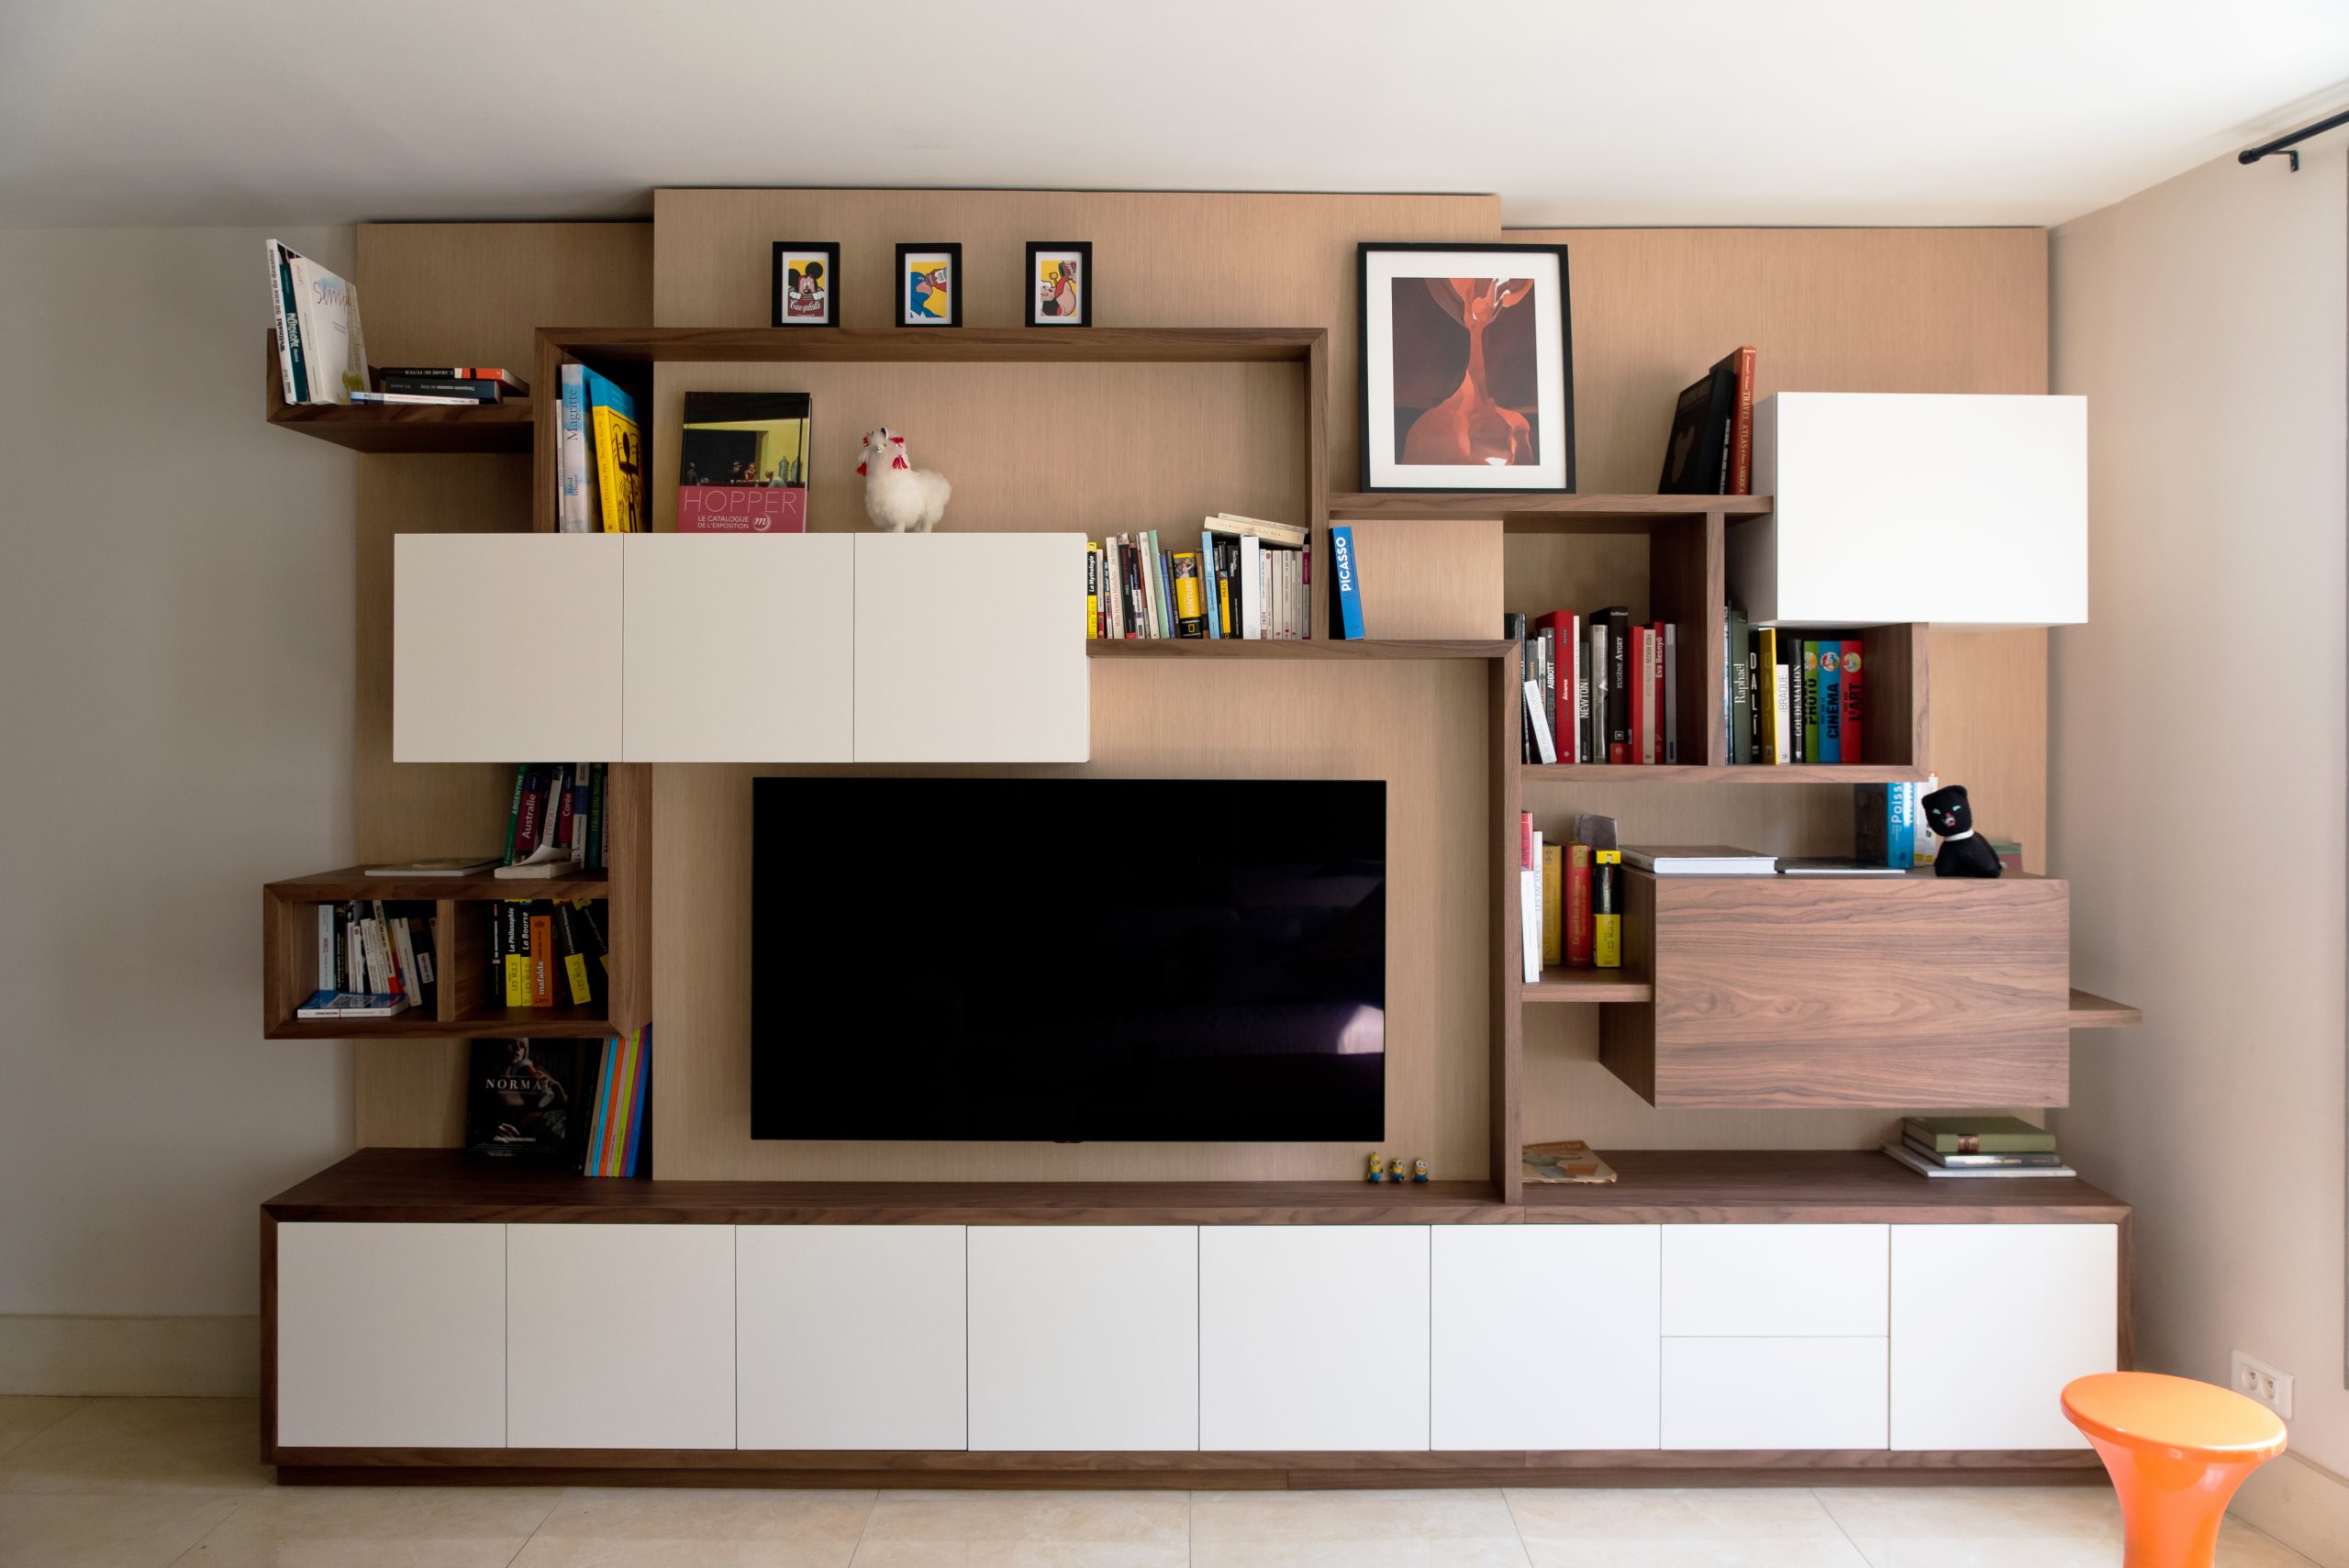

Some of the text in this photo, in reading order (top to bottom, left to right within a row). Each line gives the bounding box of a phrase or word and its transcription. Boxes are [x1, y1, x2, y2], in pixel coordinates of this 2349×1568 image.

[268, 249, 277, 278] dessins
[276, 317, 286, 352] Wolinski
[566, 389, 580, 440] Magritte
[1742, 391, 1751, 421] TRAVEL
[1740, 425, 1749, 449] ATLAS
[602, 475, 610, 504] Political
[684, 489, 797, 514] HOPPER
[707, 515, 750, 523] CATALOGUE
[1336, 537, 1352, 592] PICASSO
[1089, 584, 1095, 593] La
[1186, 579, 1195, 616] PEINTURE
[1615, 662, 1623, 689] EUGÈNE
[1733, 663, 1750, 704] Raphaël
[1777, 674, 1788, 710] BRAQUE
[1579, 682, 1589, 718] NEWTON
[1793, 664, 1803, 737] GOUDEMALION
[1825, 683, 1840, 739] CINÉMA
[1848, 683, 1862, 721] L'ART
[511, 773, 524, 816] ARGENTINE
[562, 792, 572, 817] Corée
[591, 773, 600, 832] ITALIE DU NORD
[1890, 783, 1902, 824] Poiss
[521, 794, 537, 839] Australie
[507, 907, 516, 945] Philosophie
[520, 911, 529, 951] La Bourse
[536, 961, 545, 995] mafalda
[573, 961, 584, 991] LES NULS
